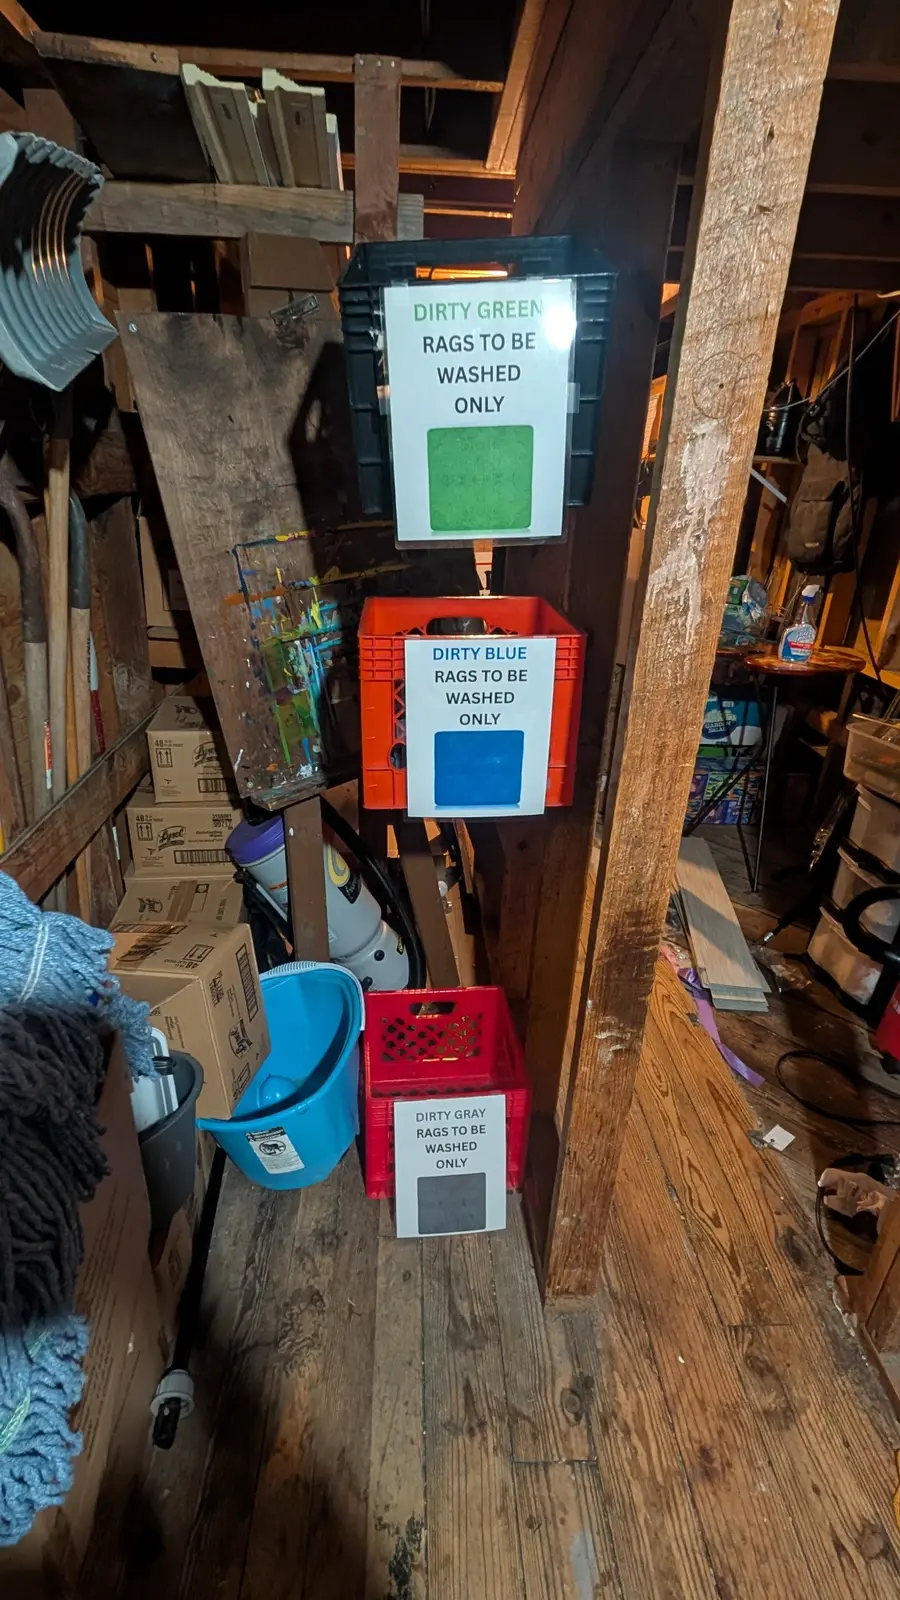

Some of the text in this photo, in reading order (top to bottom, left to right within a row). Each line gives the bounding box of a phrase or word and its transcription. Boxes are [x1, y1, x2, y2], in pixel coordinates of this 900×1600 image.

[414, 300, 543, 322] DIRTY GREEN
[423, 332, 536, 353] RAGS TO BE
[437, 364, 521, 384] WASHED
[454, 396, 504, 414] ONLY
[432, 646, 527, 660] DIRTY BLUE
[435, 669, 528, 683] RAGS TO BE
[446, 691, 515, 705] WASHED
[459, 713, 501, 726] ONLY
[155, 740, 164, 748] 48
[136, 814, 145, 822] 48
[159, 827, 185, 843] Lysol
[416, 1108, 487, 1122] DIRTY GRAY
[416, 1124, 486, 1139] RAGS TO BE
[425, 1141, 478, 1154] WASHED
[436, 1157, 468, 1169] ONLY
